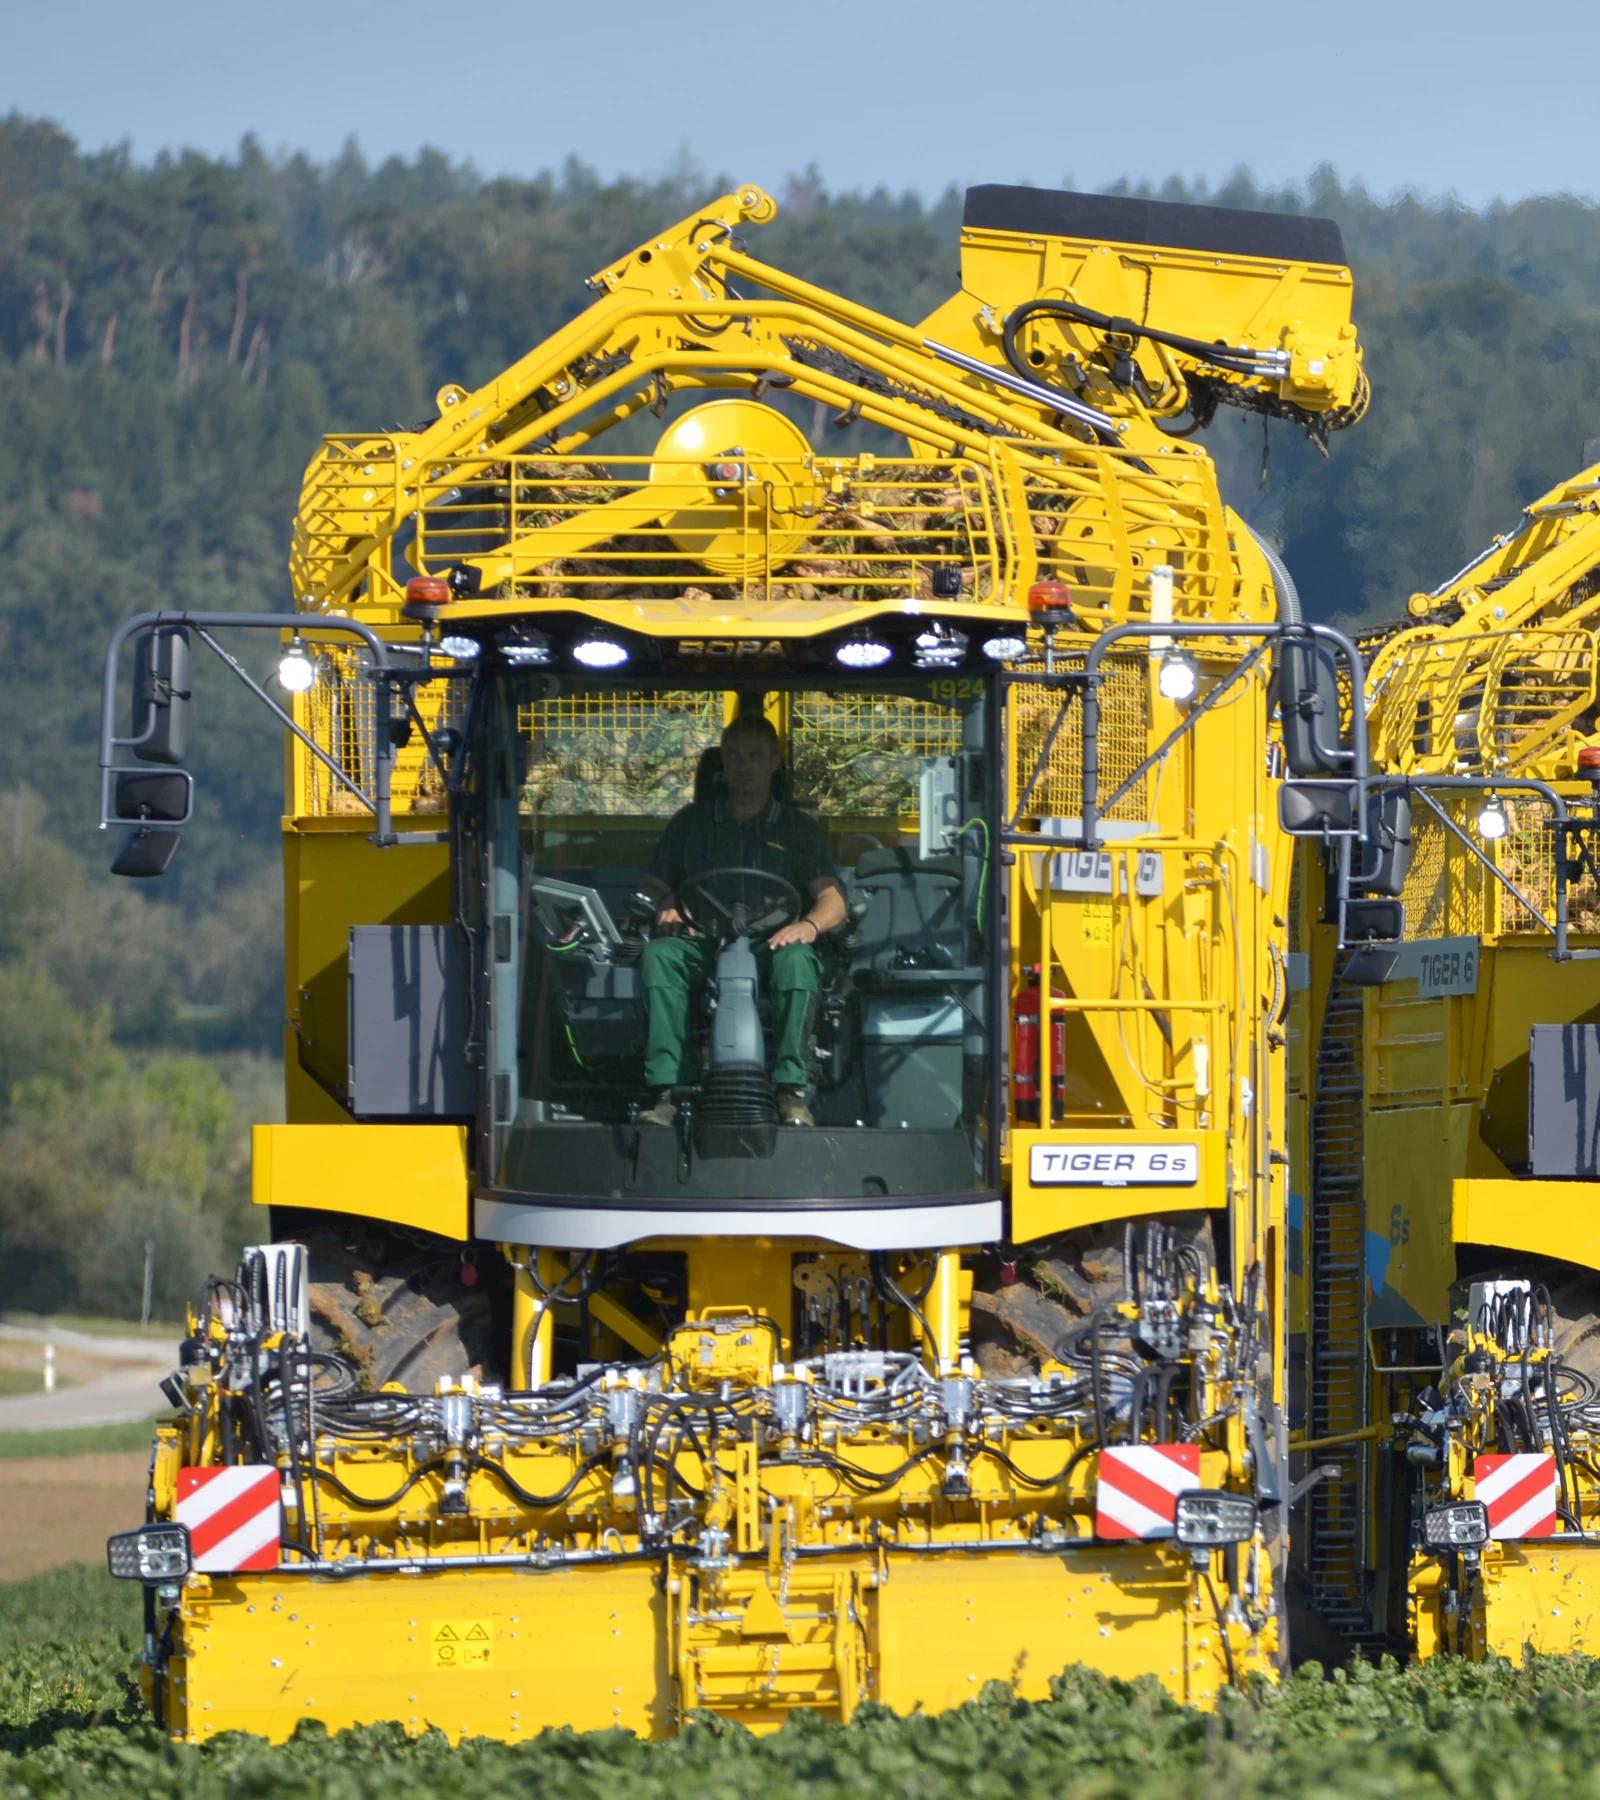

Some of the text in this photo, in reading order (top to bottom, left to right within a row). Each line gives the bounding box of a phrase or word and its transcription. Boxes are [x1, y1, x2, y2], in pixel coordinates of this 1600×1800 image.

[677, 640, 786, 658] ROPA
[928, 677, 985, 700] 1924
[1054, 851, 1128, 879] IGE
[1421, 951, 1474, 987] TIGER 6
[1043, 1154, 1187, 1171] TIGER 6s
[1389, 1203, 1410, 1246] 6s
